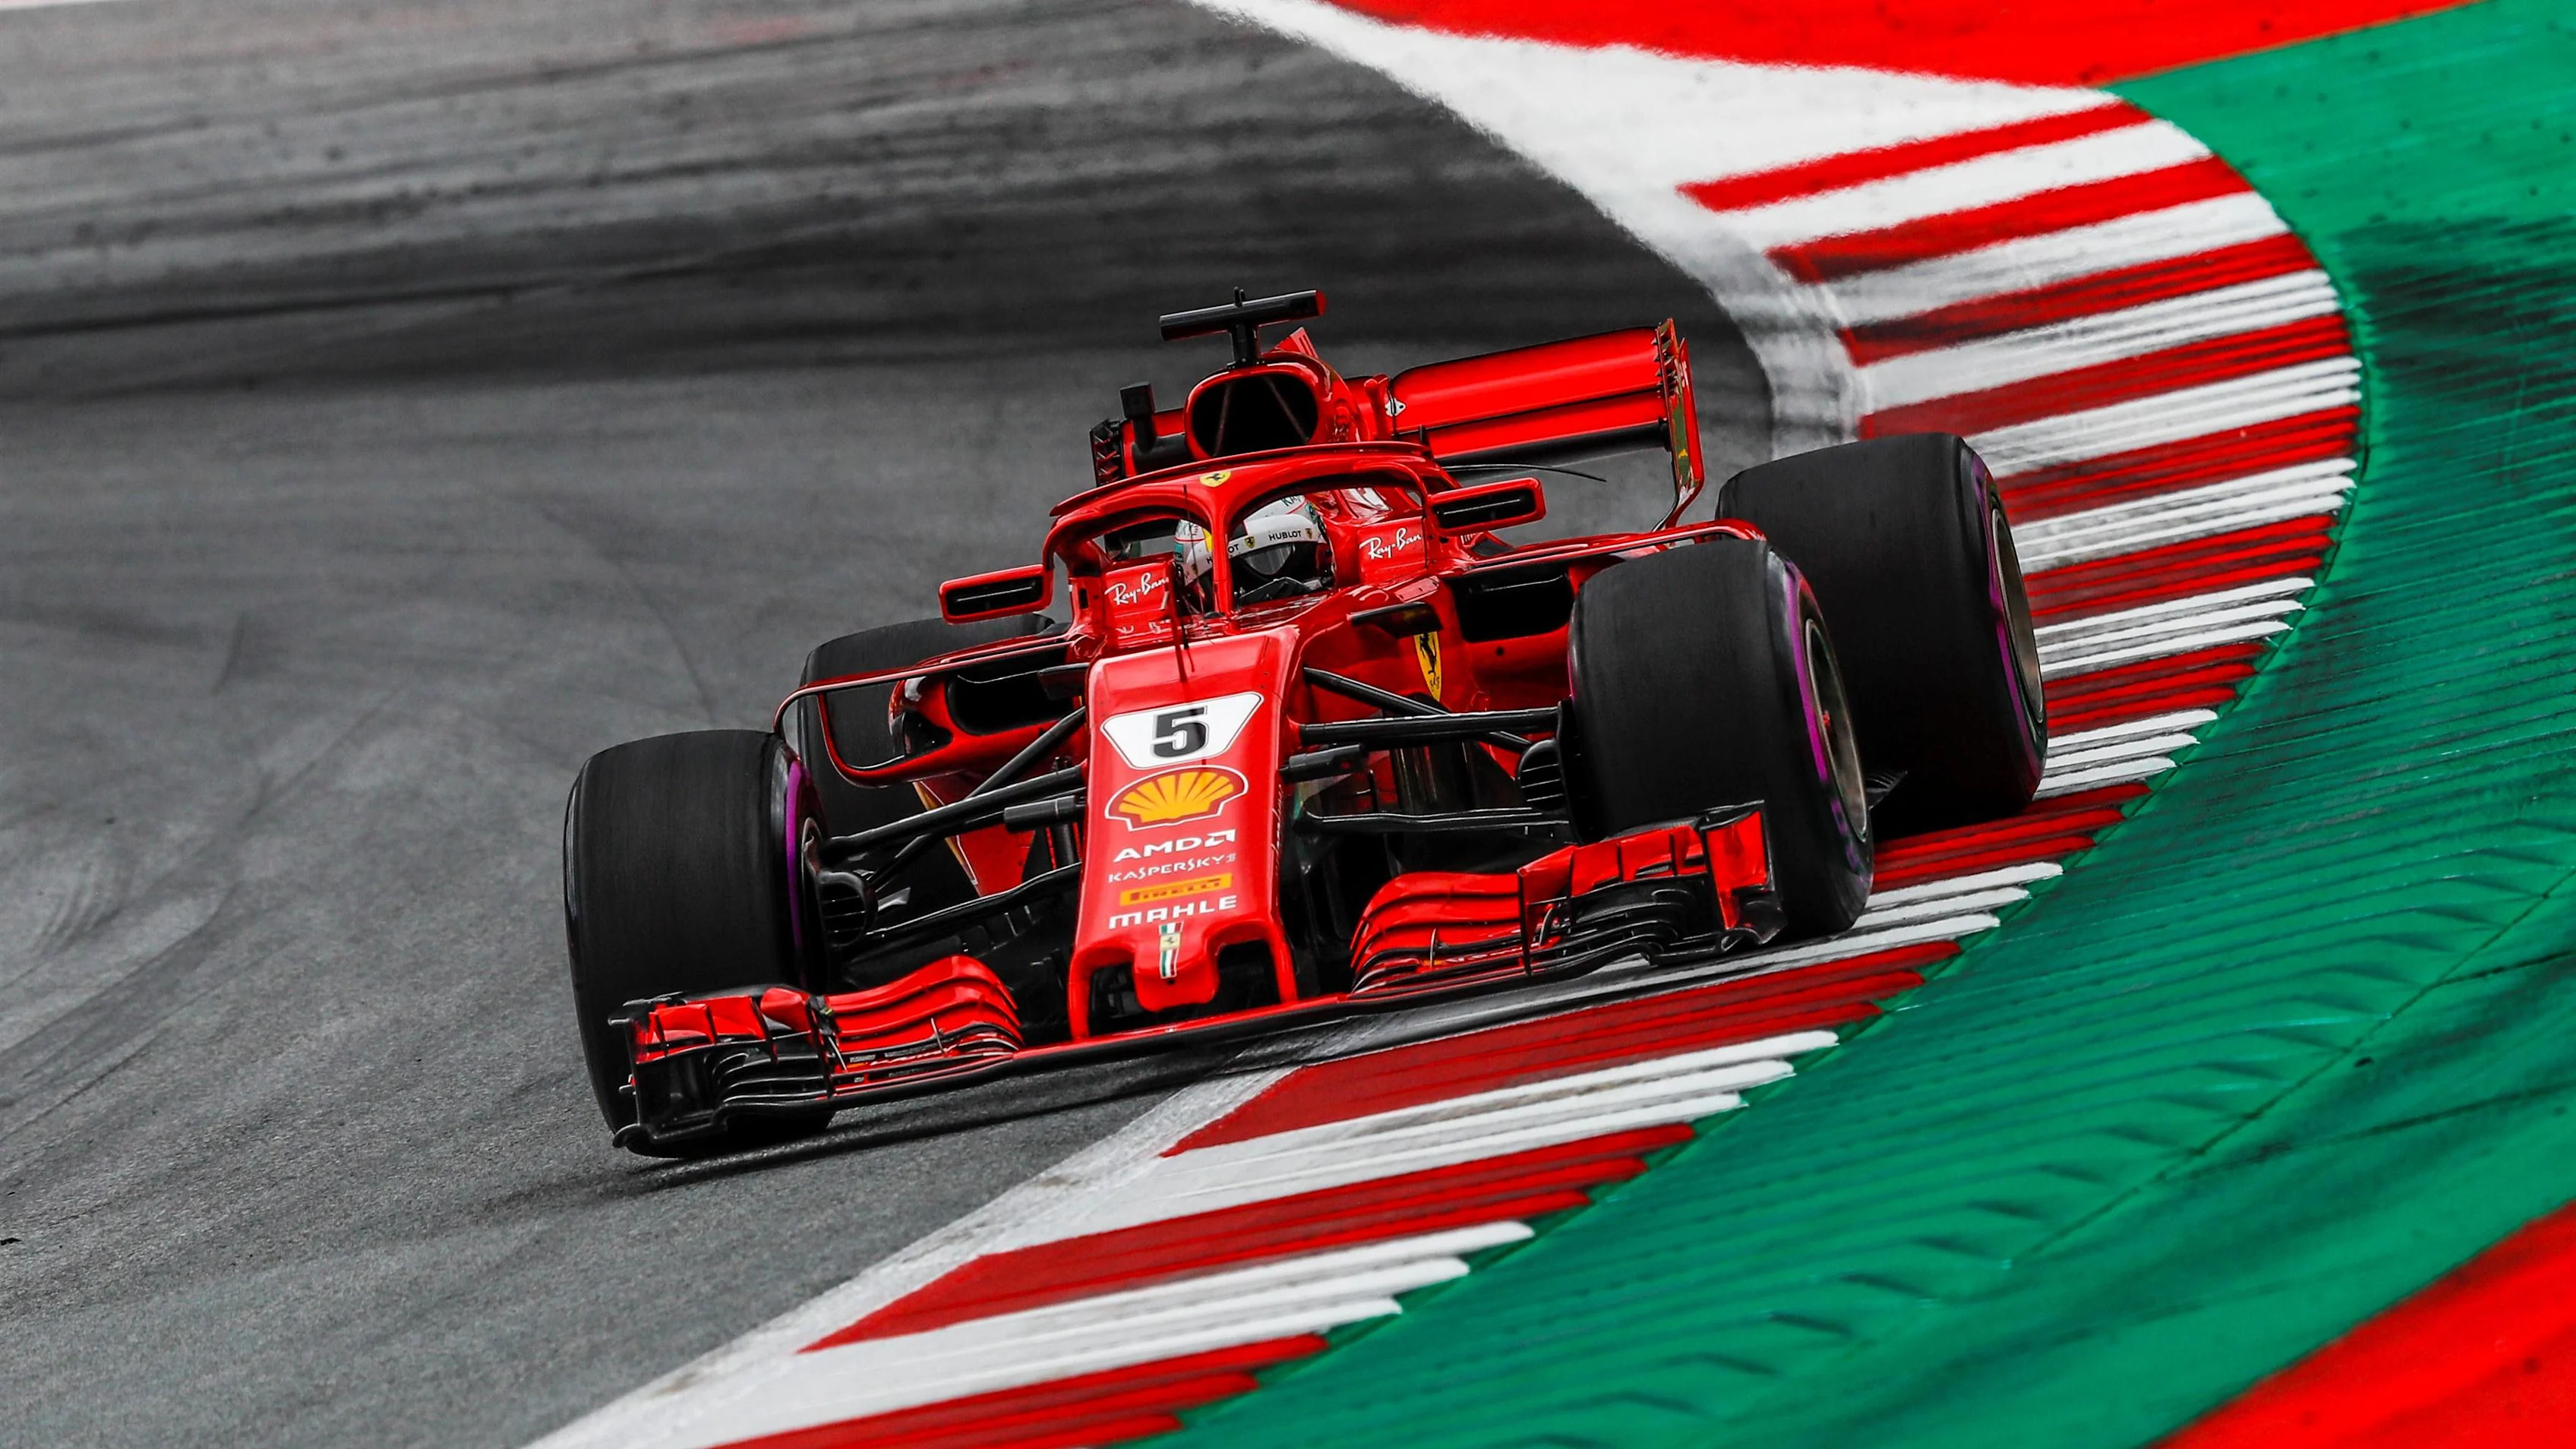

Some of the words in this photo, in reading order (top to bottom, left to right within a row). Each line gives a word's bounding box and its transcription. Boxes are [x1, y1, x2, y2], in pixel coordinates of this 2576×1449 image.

[1269, 530, 1302, 541] HUBLOT
[1359, 528, 1422, 560] Ray-Ban
[1104, 572, 1170, 605] Ray-Ban
[1151, 706, 1209, 758] 5
[1113, 835, 1204, 863] AMD
[1108, 854, 1225, 883] KASPERSKY
[1108, 895, 1237, 930] MAHLE
